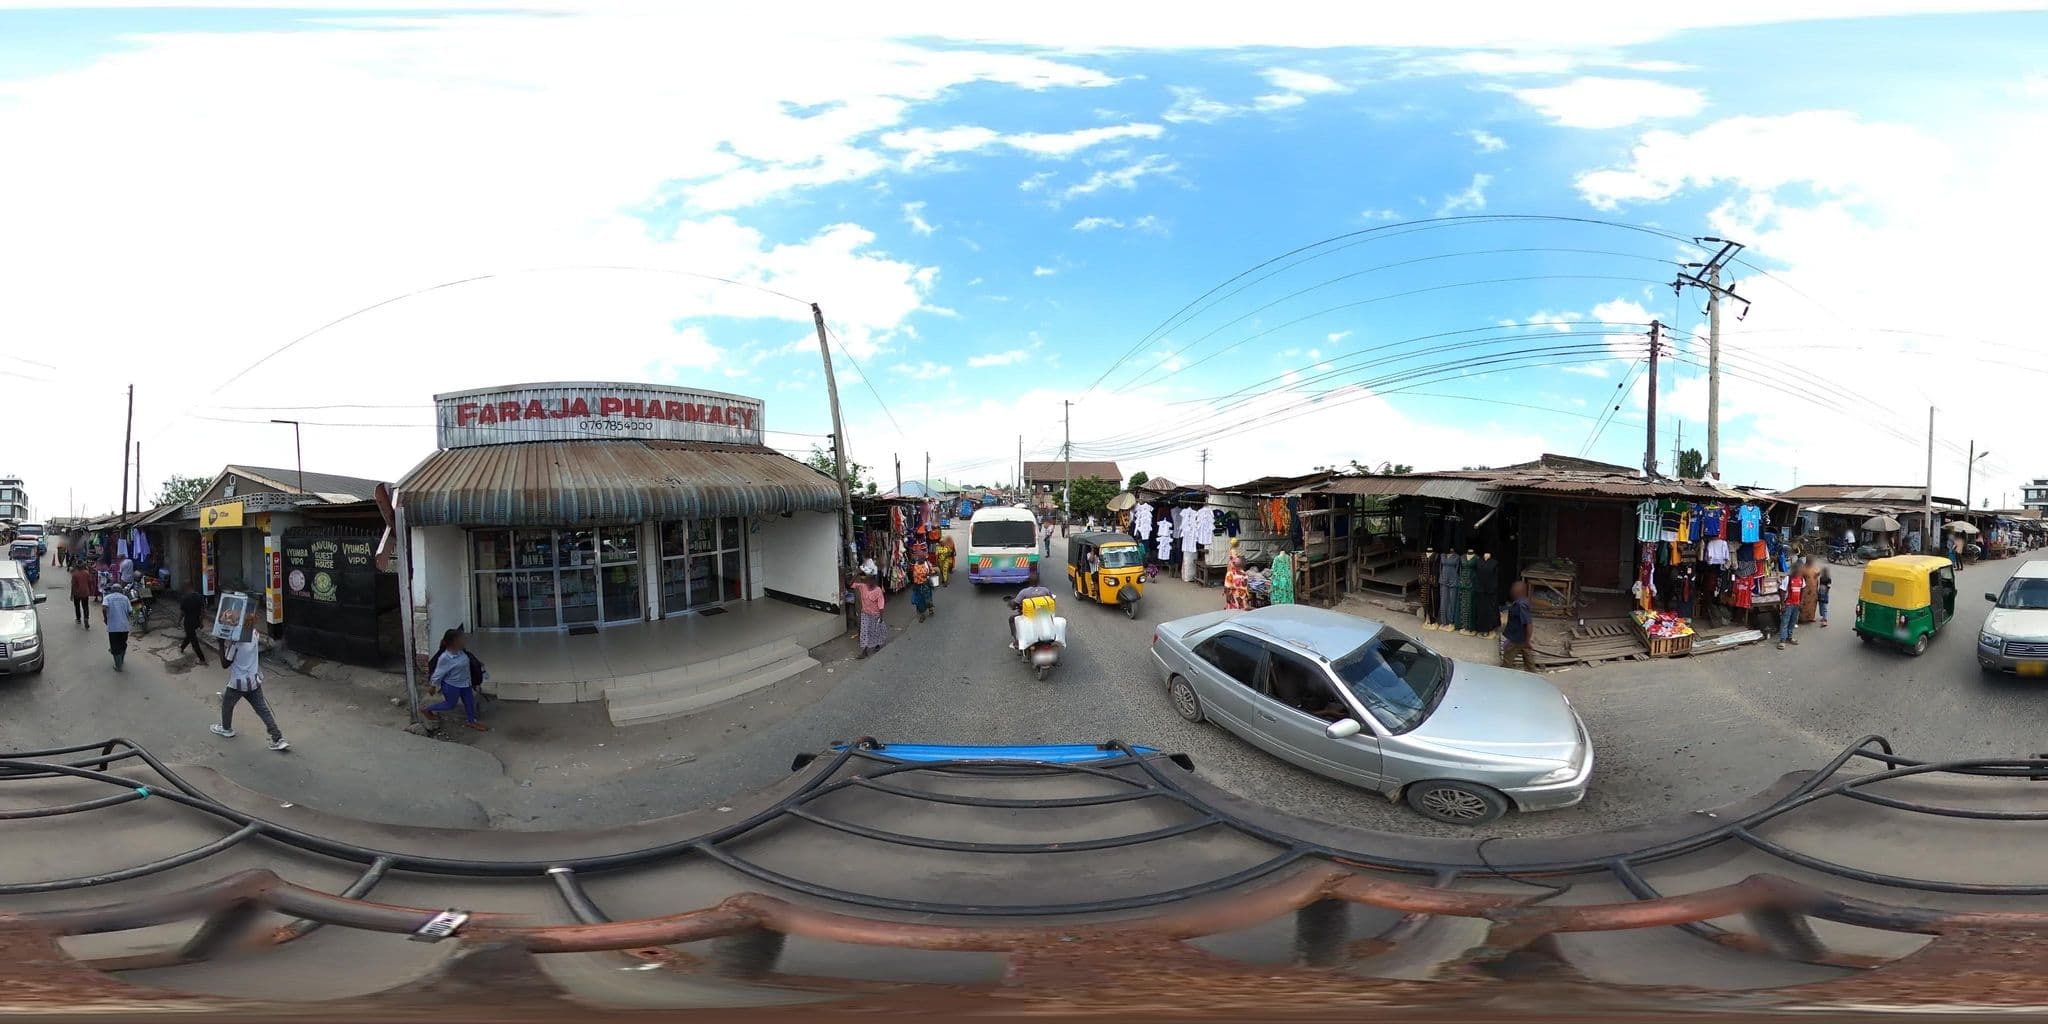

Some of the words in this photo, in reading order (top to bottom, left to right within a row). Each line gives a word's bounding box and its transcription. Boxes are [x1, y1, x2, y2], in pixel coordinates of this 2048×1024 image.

[457, 397, 591, 427] FARAJA
[600, 397, 754, 430] PHARMACY
[580, 419, 653, 431] 0767854000
[342, 543, 371, 556] VYUMBA
[315, 552, 333, 560] GUEST
[315, 560, 334, 569] HOUSE
